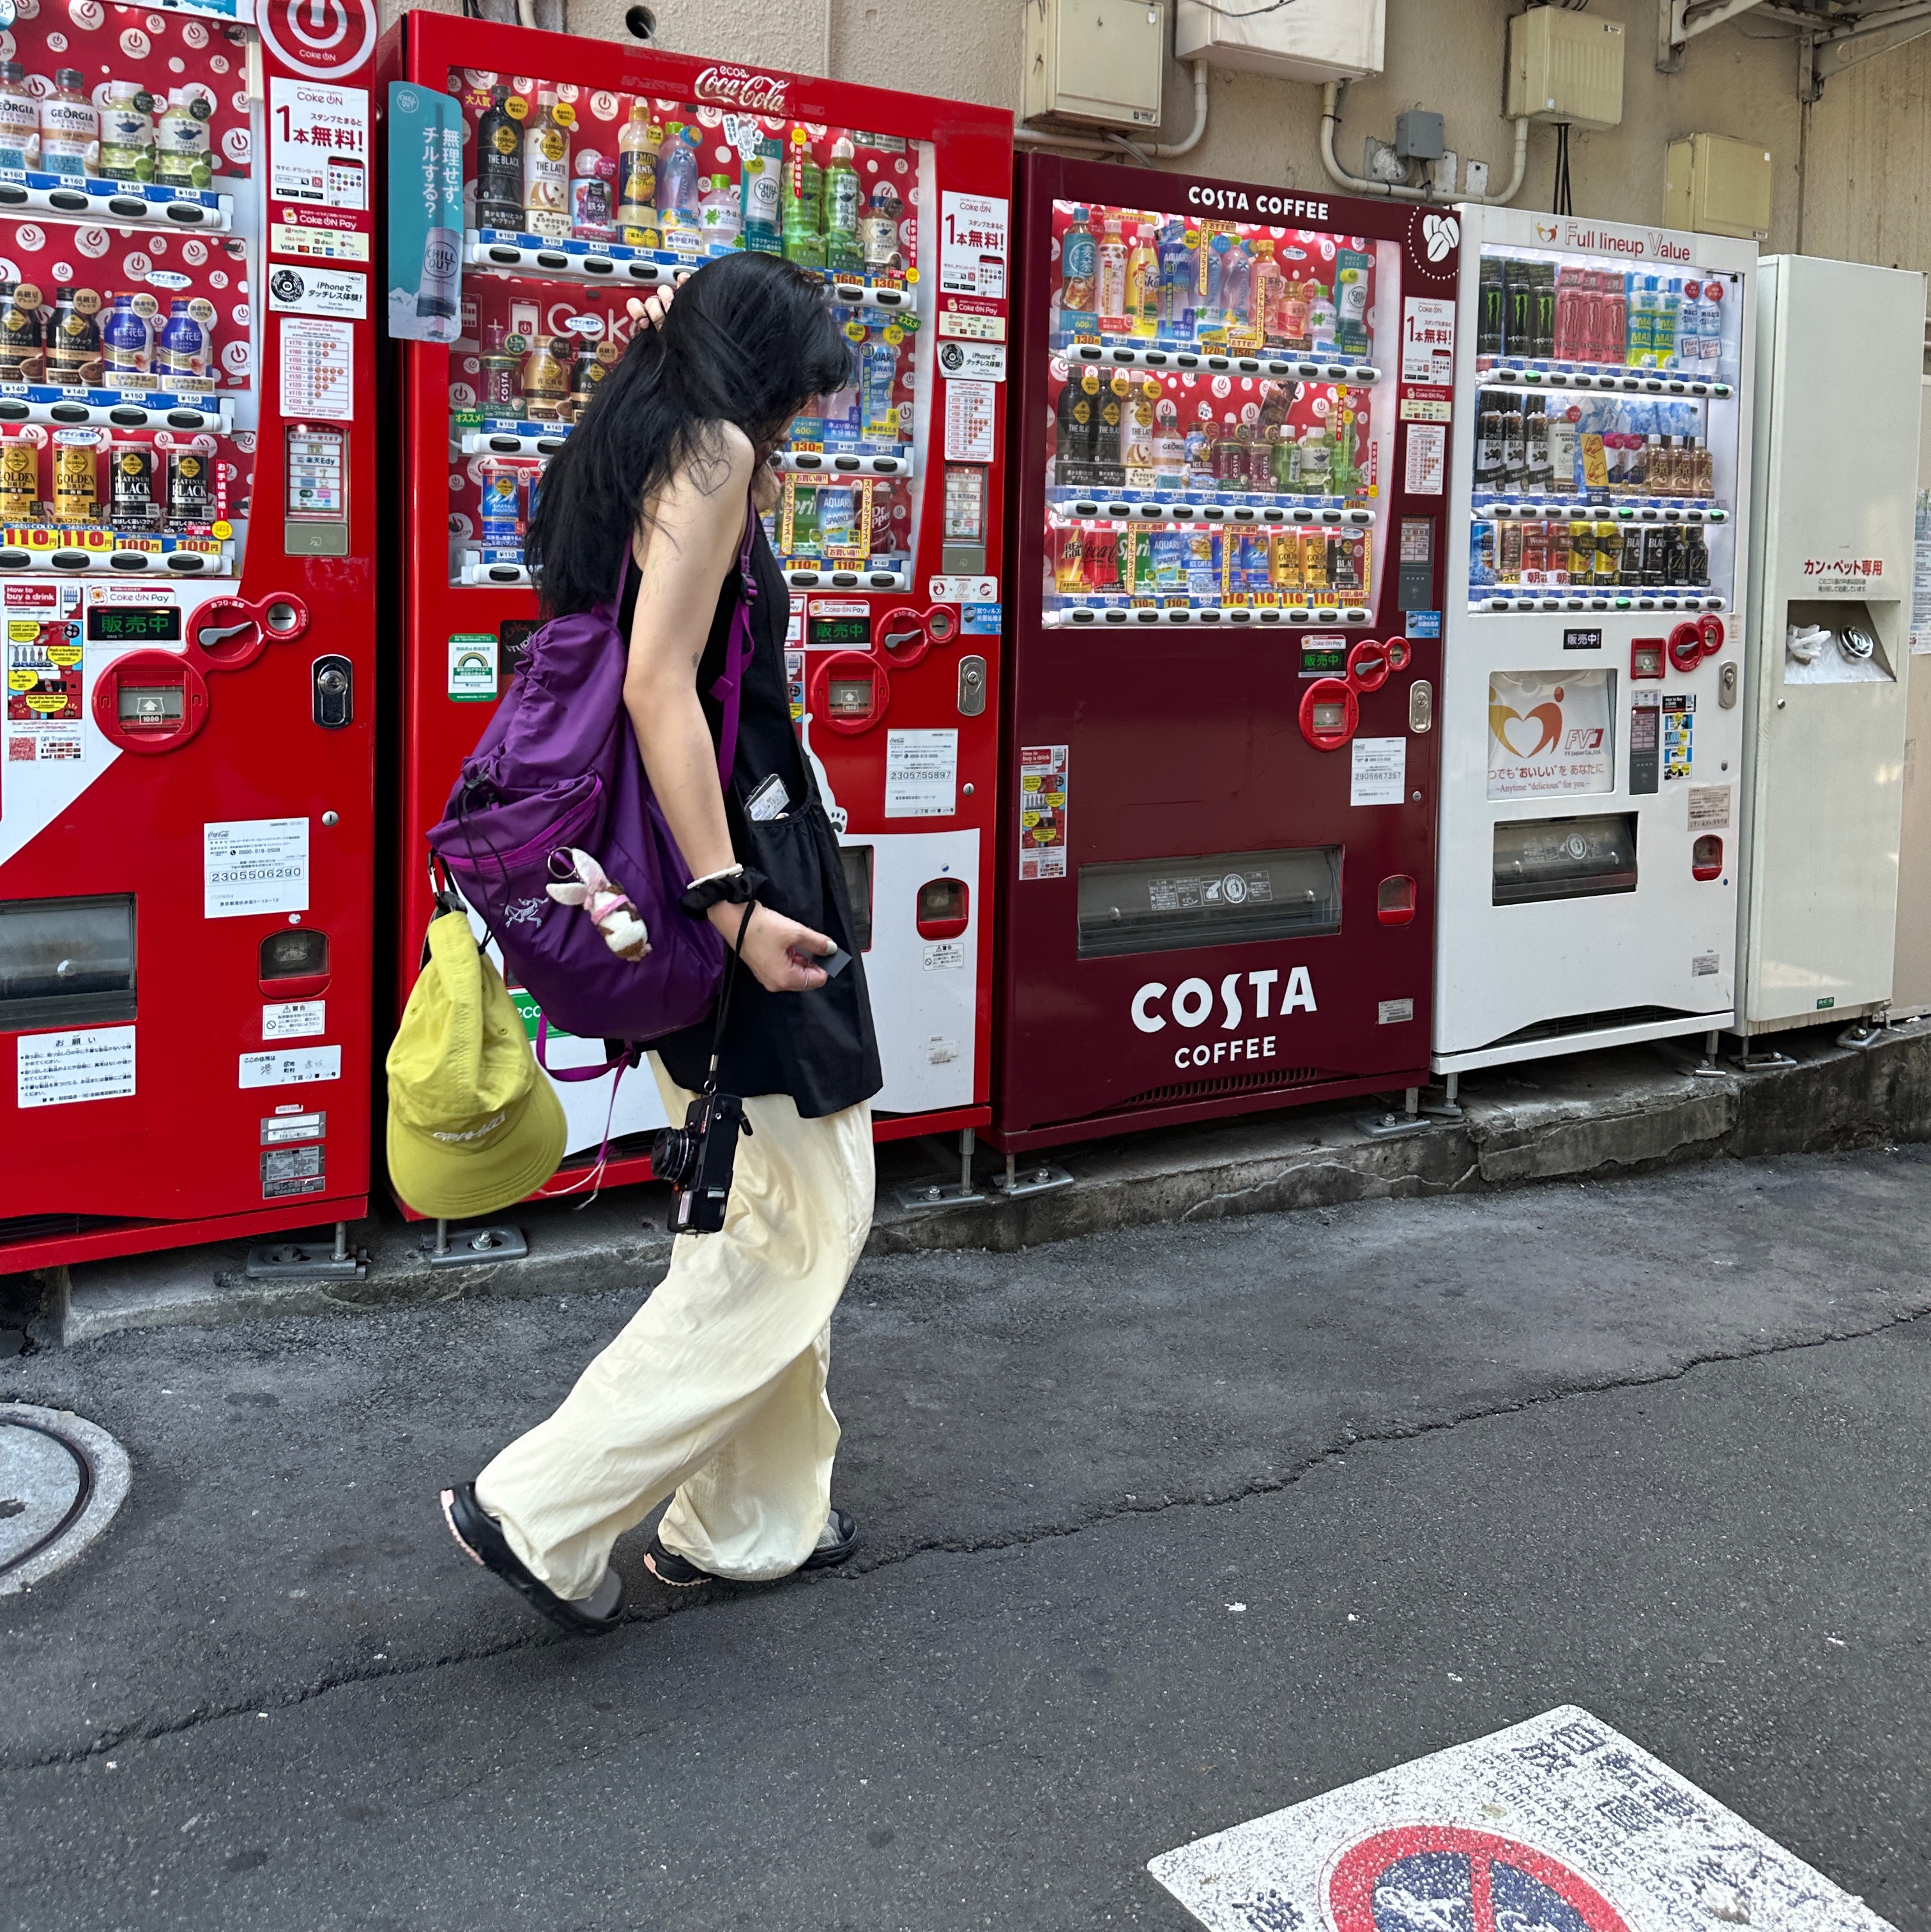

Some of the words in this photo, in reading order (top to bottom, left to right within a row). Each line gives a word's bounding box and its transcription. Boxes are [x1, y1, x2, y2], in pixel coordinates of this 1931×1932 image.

[299, 49, 321, 59] Coke
[297, 91, 324, 103] Coke
[310, 112, 362, 126] スタンプたまると
[423, 127, 439, 218] チルする?
[1188, 186, 1249, 211] COSTA
[1256, 195, 1329, 220] COFFEE
[1564, 222, 1595, 249] Full
[1599, 231, 1644, 258] lineup
[1648, 232, 1690, 261] Value
[57, 473, 95, 486] GOLDEN
[6, 529, 57, 546] 110円
[63, 530, 112, 548] 110円
[118, 539, 159, 551] 100円
[179, 540, 218, 553] 100円
[1803, 559, 1883, 576] カン・ペット専用
[102, 615, 169, 632] 販売中
[816, 624, 863, 638] 販売中
[1568, 633, 1597, 645] 販売中
[1304, 654, 1339, 668] 販売中
[212, 868, 301, 882] 2305506290
[1131, 965, 1318, 1034] COSTA
[1174, 1035, 1277, 1069] COFFEE
